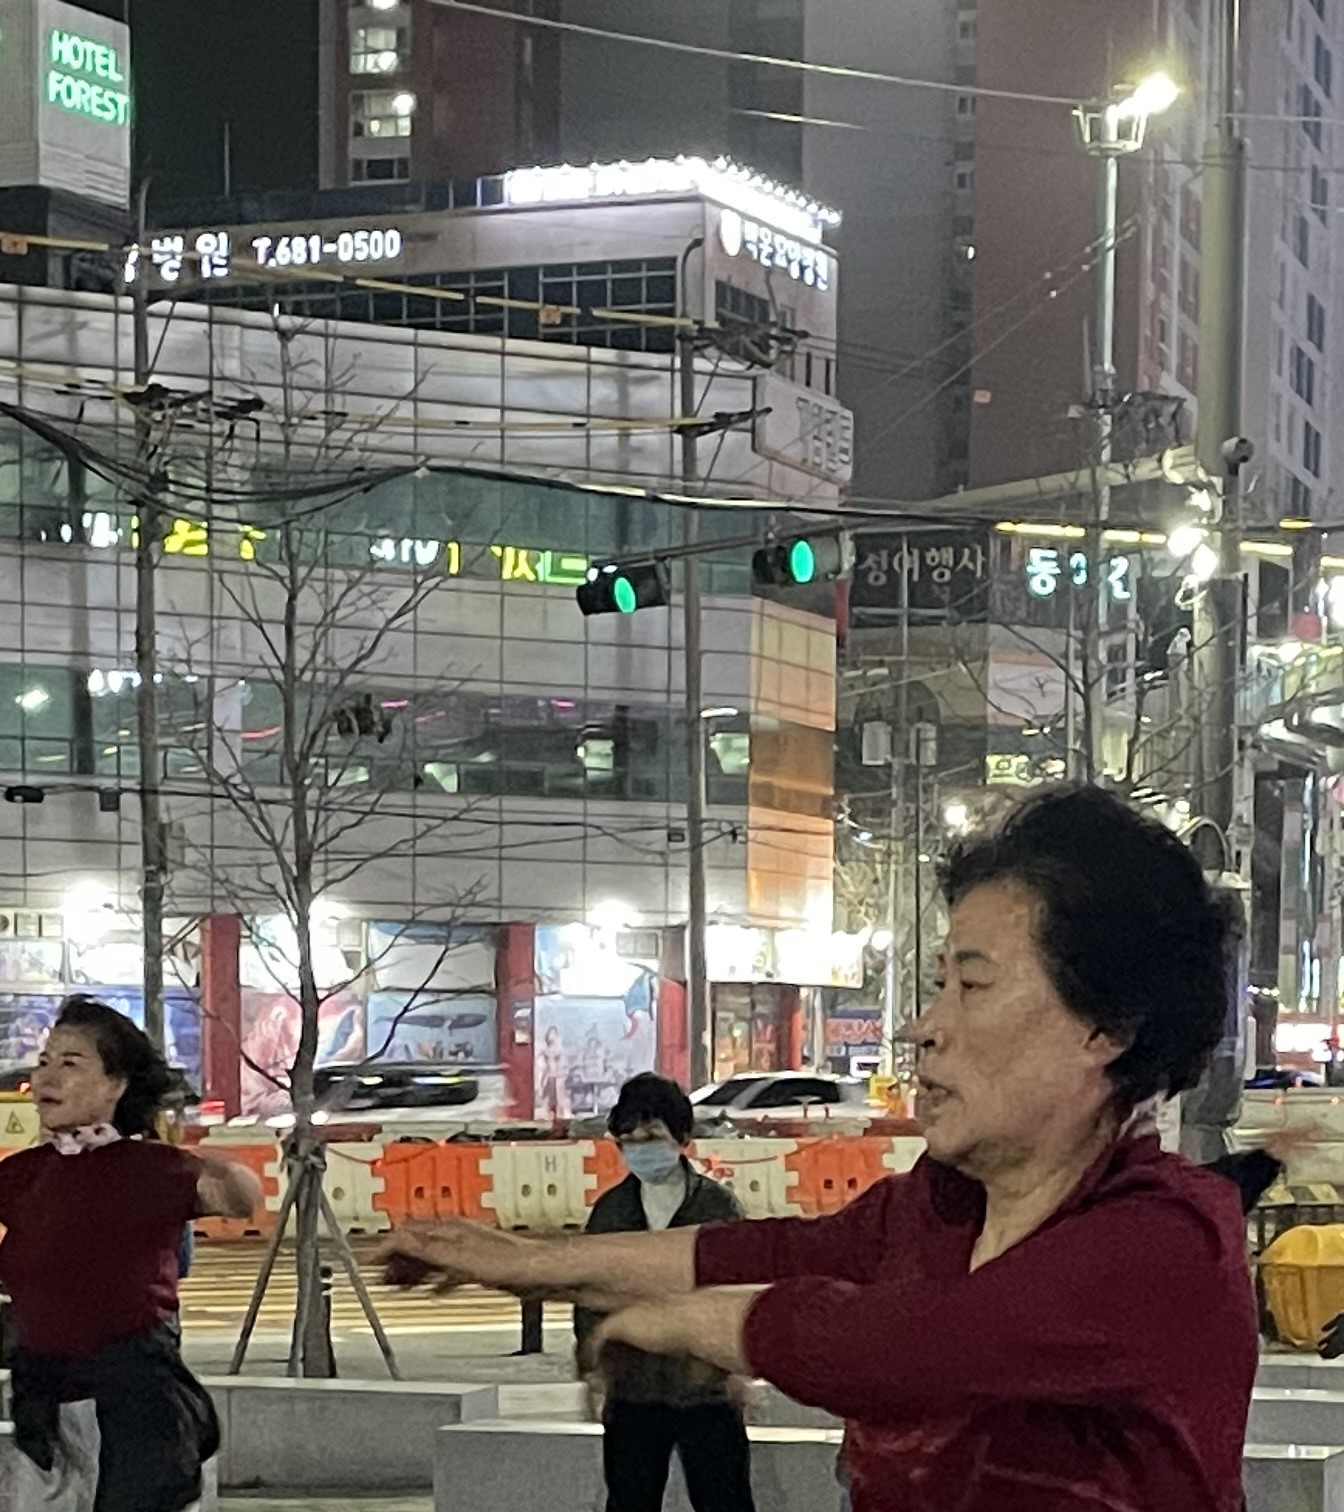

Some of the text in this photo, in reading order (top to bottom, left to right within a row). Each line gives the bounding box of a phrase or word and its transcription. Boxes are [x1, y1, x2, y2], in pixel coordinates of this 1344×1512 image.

[50, 31, 123, 79] HOTEL
[48, 71, 129, 124] FOREST
[252, 229, 402, 267] T.681-0500
